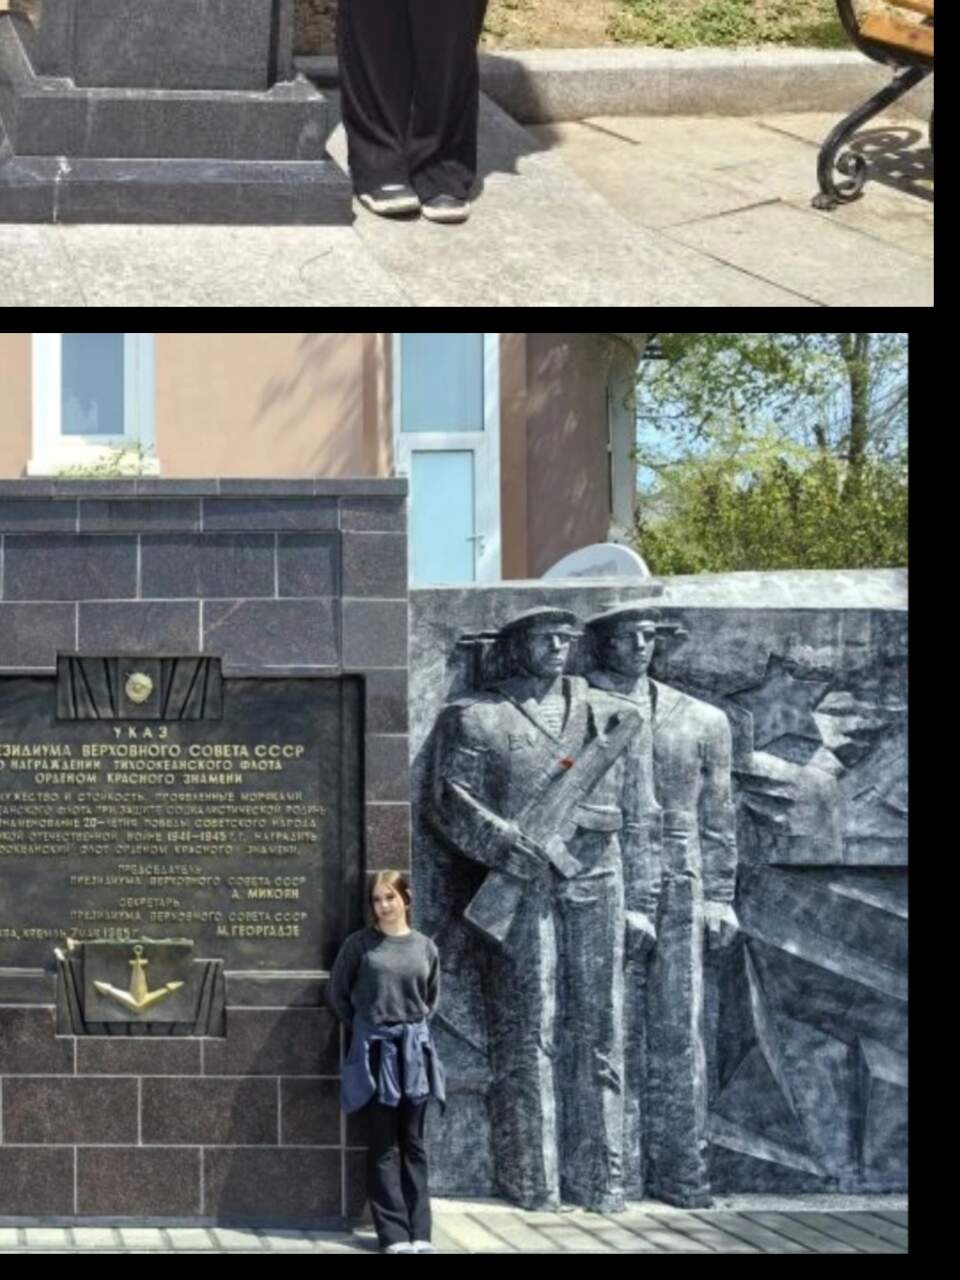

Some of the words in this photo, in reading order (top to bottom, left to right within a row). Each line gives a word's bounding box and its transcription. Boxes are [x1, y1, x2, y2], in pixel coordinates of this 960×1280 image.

[82, 744, 181, 758] ВЕРХОВНОГО
[189, 744, 249, 758] СОВЕТА
[254, 744, 304, 758] СССР
[10, 759, 101, 771] НАГРАЖДЕНИИ
[114, 759, 233, 771] ТИХООКЕАНСКОГО
[240, 759, 283, 771] ФЛОТА
[34, 773, 97, 785] ОРДЕНОМ
[107, 773, 175, 785] КРАСНОГО
[183, 773, 242, 785] ЗНАМЕНИ
[64, 792, 72, 802] И
[274, 876, 307, 886] СССР
[248, 888, 299, 899] МИКОЯН
[274, 911, 308, 922] СССР
